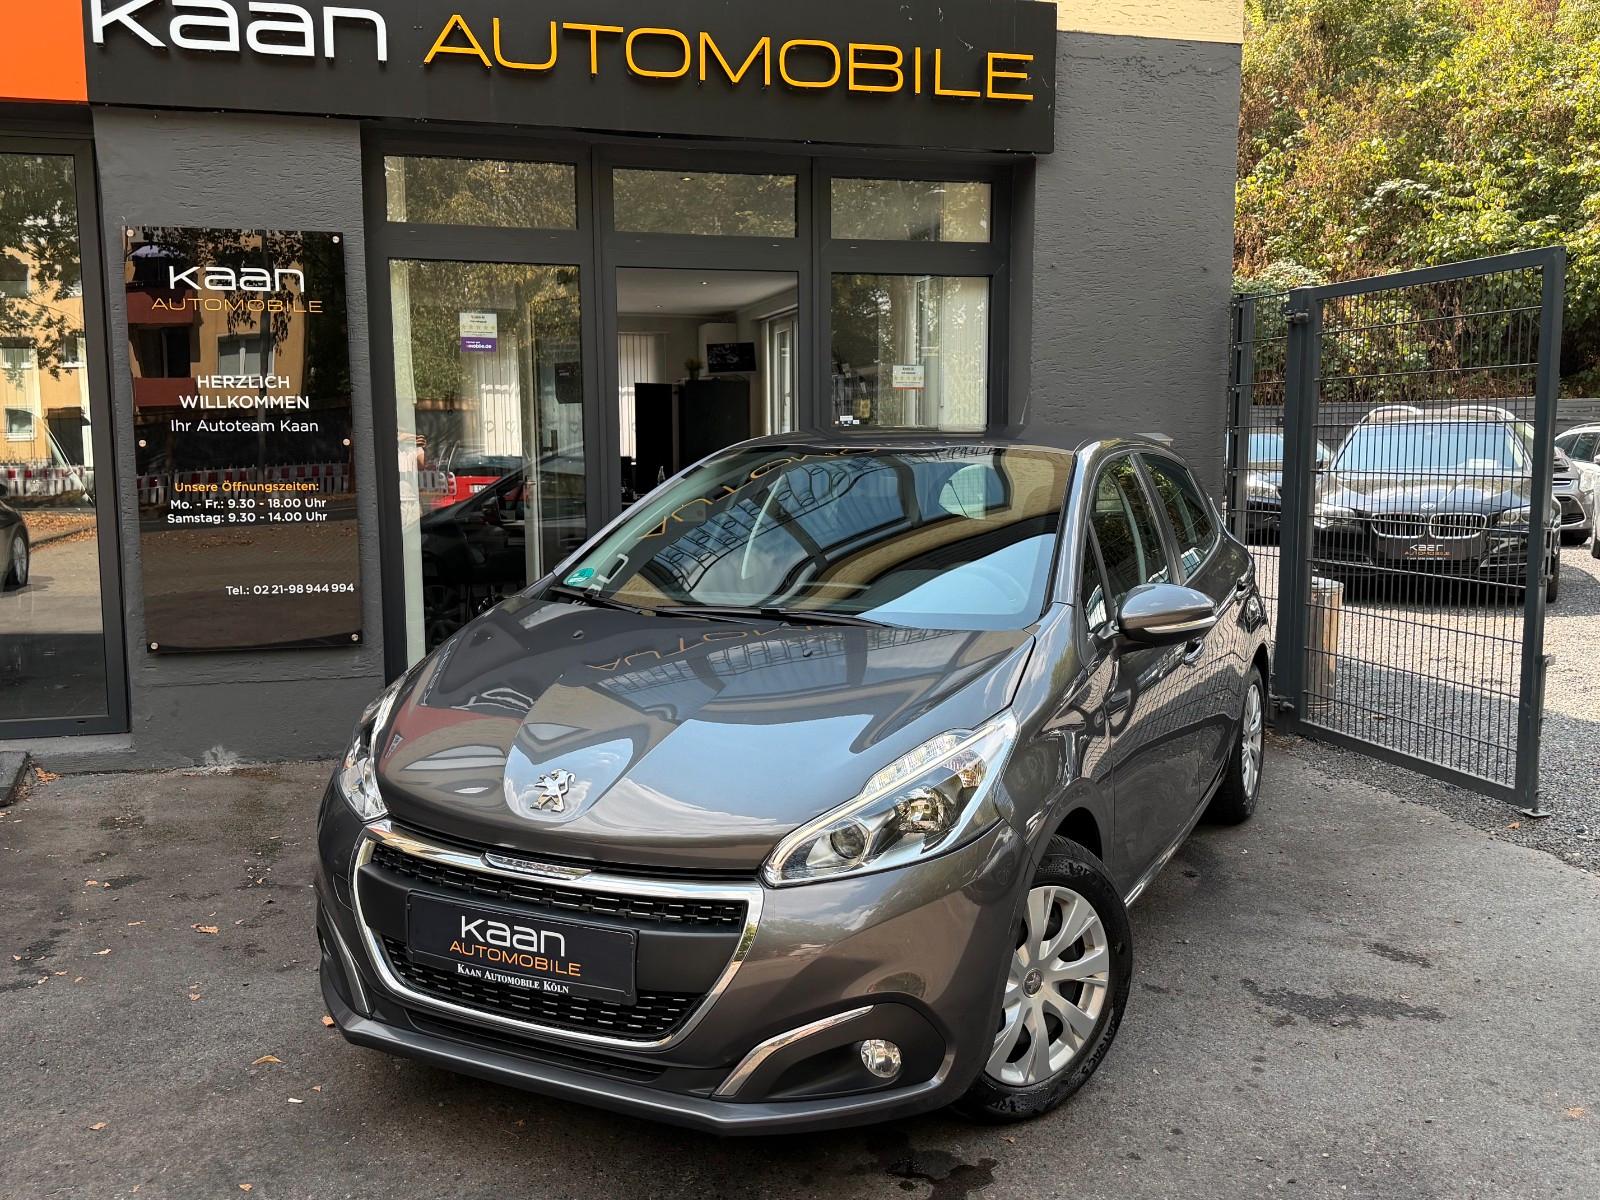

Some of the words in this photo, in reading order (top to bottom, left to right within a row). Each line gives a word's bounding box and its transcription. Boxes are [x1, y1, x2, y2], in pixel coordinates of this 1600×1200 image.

[90, 0, 388, 62] kaan
[423, 14, 1036, 102] AUTOMOBILE
[168, 265, 305, 293] kaan
[151, 297, 324, 314] AUTOMOBILE
[197, 375, 290, 389] HERZLICH
[178, 395, 310, 409] WILLKOMMEN
[170, 419, 192, 432] Ihr
[196, 419, 276, 432] Autoteam
[280, 419, 319, 432] Kaan
[174, 482, 218, 493] Unsere
[221, 480, 320, 493] Öffnungszeiten:
[170, 499, 193, 510] Mo.
[205, 499, 224, 509] Fr.:
[227, 498, 256, 509] 9.30
[267, 498, 301, 509] 18.00
[304, 498, 327, 508] Uhr
[167, 512, 225, 524] Samstag:
[228, 512, 256, 523] 9.30
[268, 511, 302, 522] 14.00
[305, 511, 328, 522] Uhr
[225, 585, 250, 596] Tel.:
[461, 915, 566, 957] kaan
[449, 940, 582, 977] AUTOMOBILE
[484, 970, 540, 989] AUTOMOBILE
[543, 980, 569, 994] KÖLN
